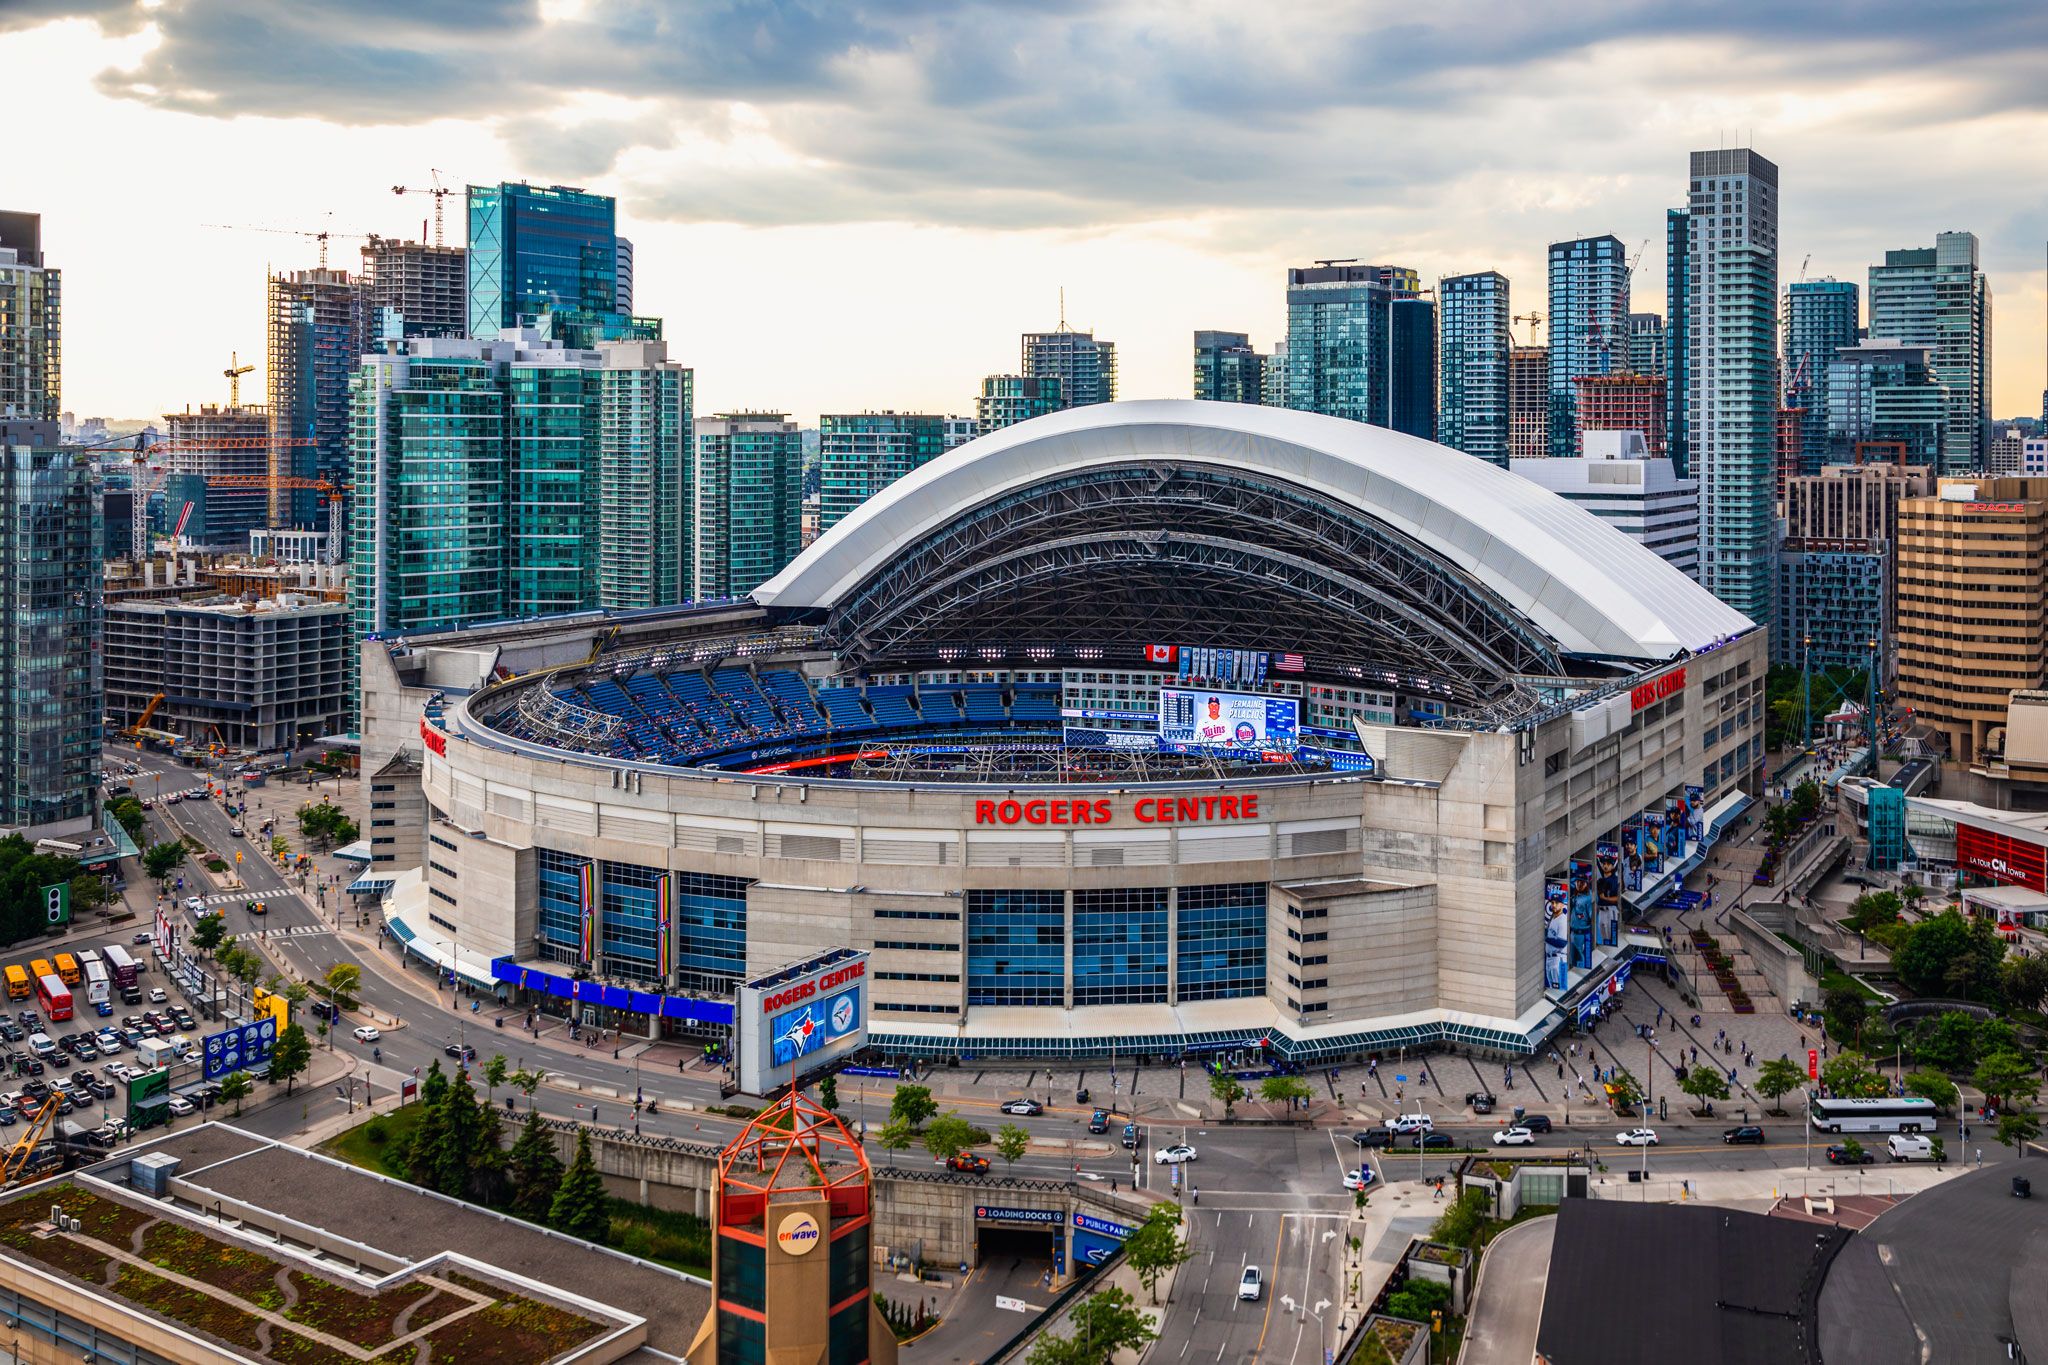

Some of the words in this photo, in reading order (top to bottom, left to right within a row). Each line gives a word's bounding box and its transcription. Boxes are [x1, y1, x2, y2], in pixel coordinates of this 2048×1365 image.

[1963, 503, 2025, 513] ORACLE
[1229, 709, 1265, 720] PALACIOS
[1203, 725, 1226, 738] Twins
[1236, 729, 1255, 740] Twins
[975, 799, 1112, 825] ROGERS
[1134, 794, 1259, 823] CENTRE
[1969, 856, 1977, 864] LA
[1977, 858, 1991, 868] TOUR
[1991, 858, 2006, 872] CN
[2007, 867, 2026, 879] TOWER
[763, 980, 816, 1014] ROGERS
[819, 960, 865, 992] CENTRE
[988, 1210, 1025, 1219] LOADING
[1025, 1211, 1052, 1221] DOCKS
[1085, 1219, 1108, 1232] PUBLIC
[779, 1229, 818, 1241] enwave
